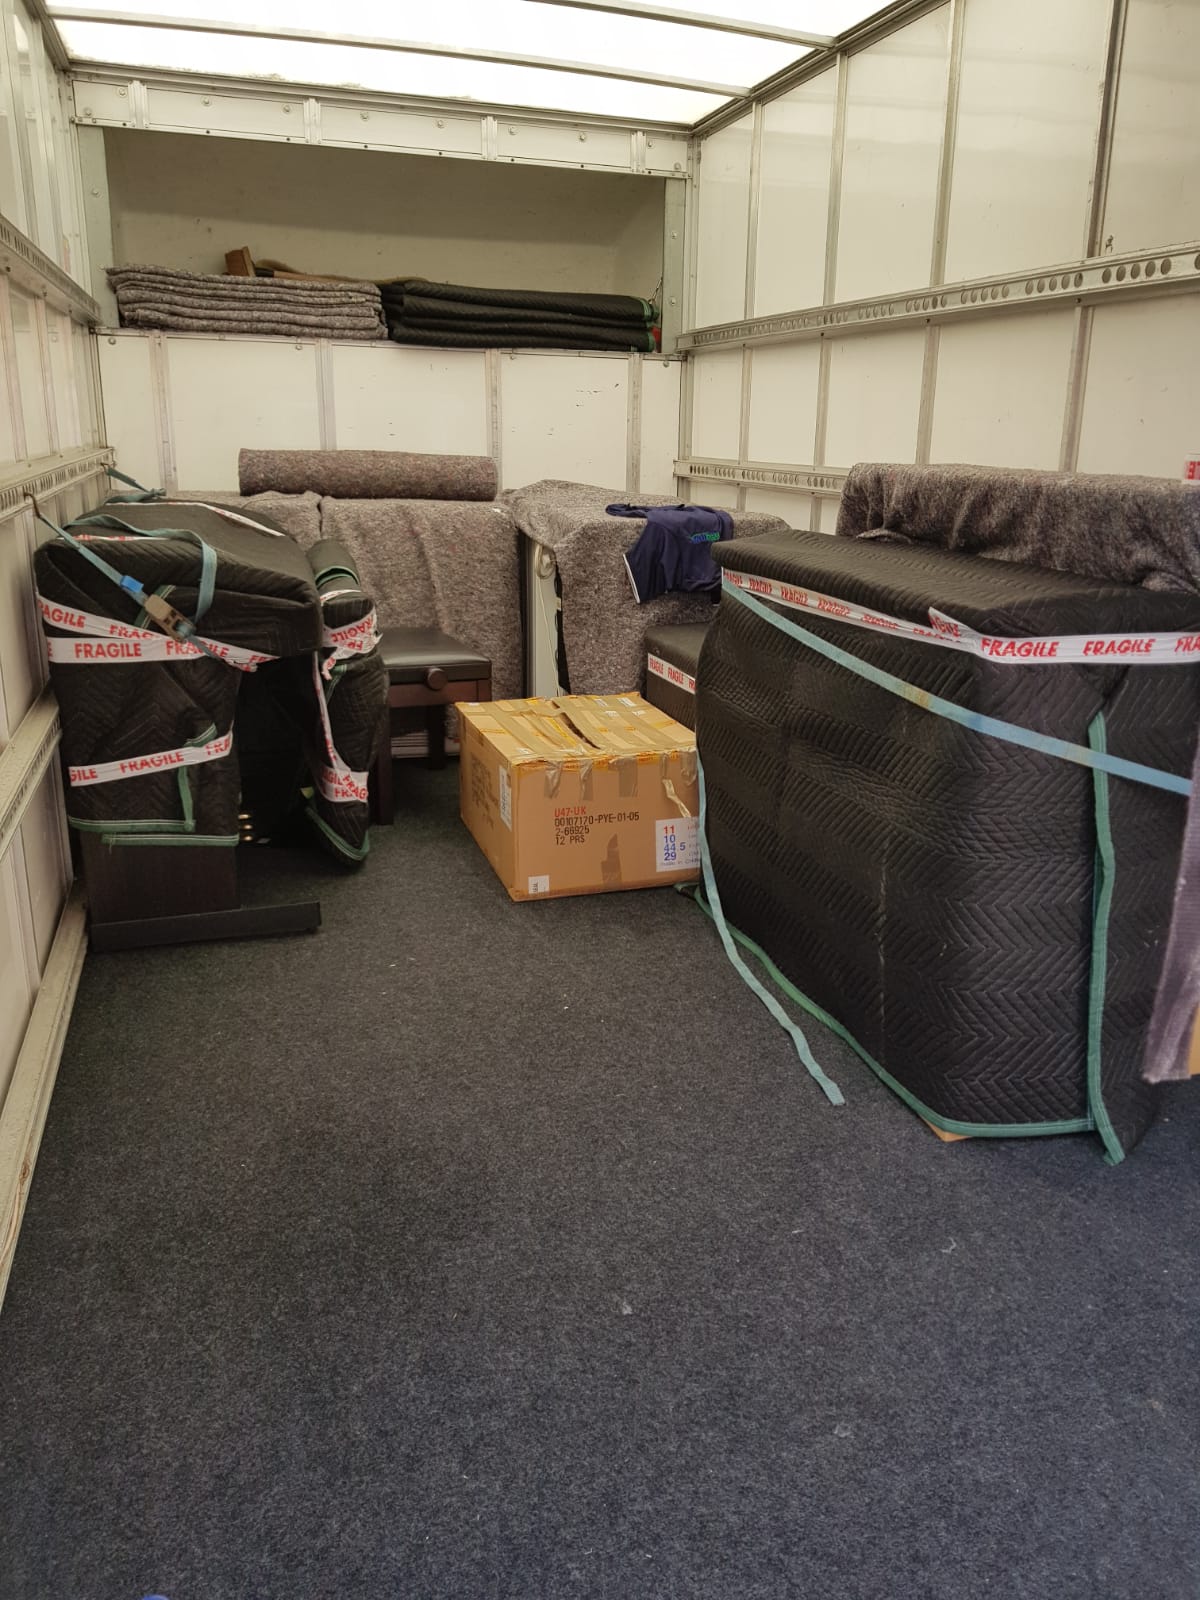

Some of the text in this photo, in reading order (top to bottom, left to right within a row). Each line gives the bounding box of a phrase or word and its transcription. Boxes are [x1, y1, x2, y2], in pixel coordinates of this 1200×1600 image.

[74, 643, 142, 659] FRAGILE
[981, 637, 1060, 658] FRAGILE
[1083, 638, 1155, 657] FRAGILE
[119, 751, 185, 774] FRAGILE
[569, 834, 585, 845] PRS
[663, 851, 677, 861] 29
